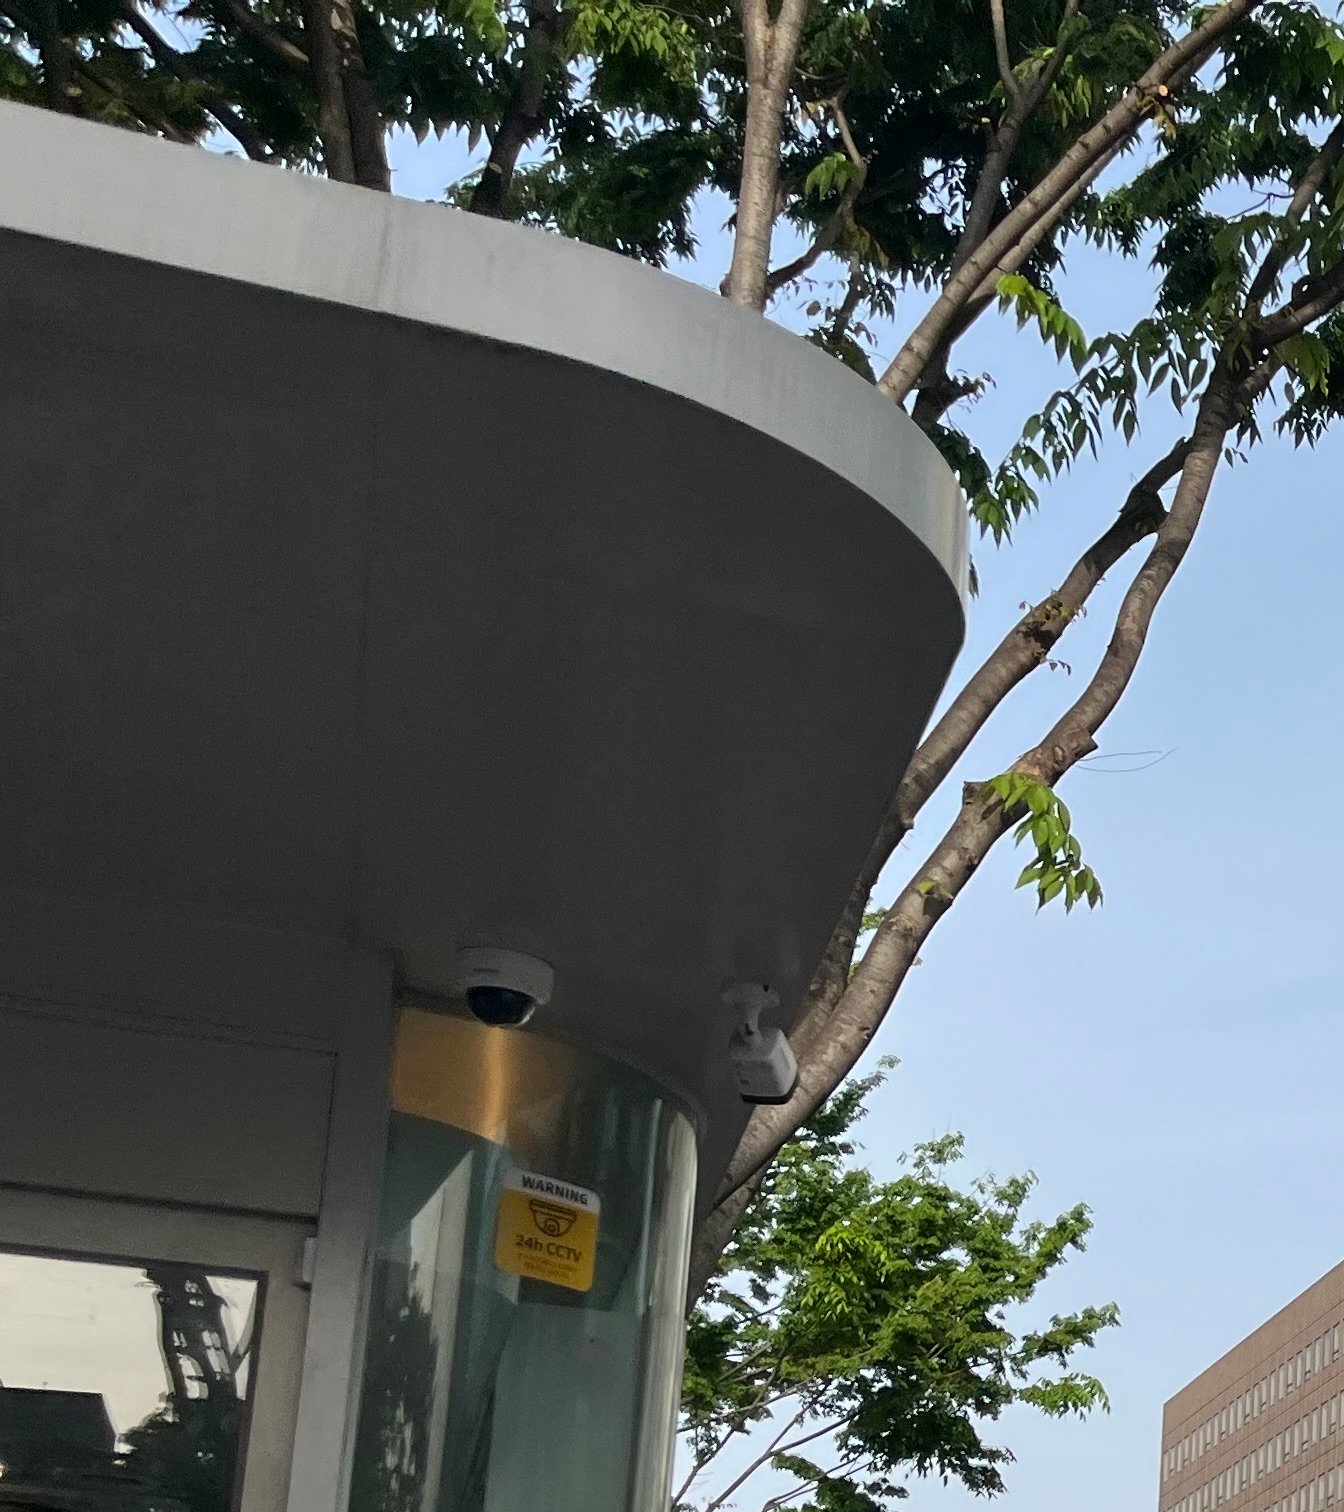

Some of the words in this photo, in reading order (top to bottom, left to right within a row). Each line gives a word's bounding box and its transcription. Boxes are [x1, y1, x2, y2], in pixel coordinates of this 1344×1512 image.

[522, 1174, 589, 1205] WARNING
[515, 1233, 543, 1252] 24h
[547, 1242, 582, 1263] CCTV
